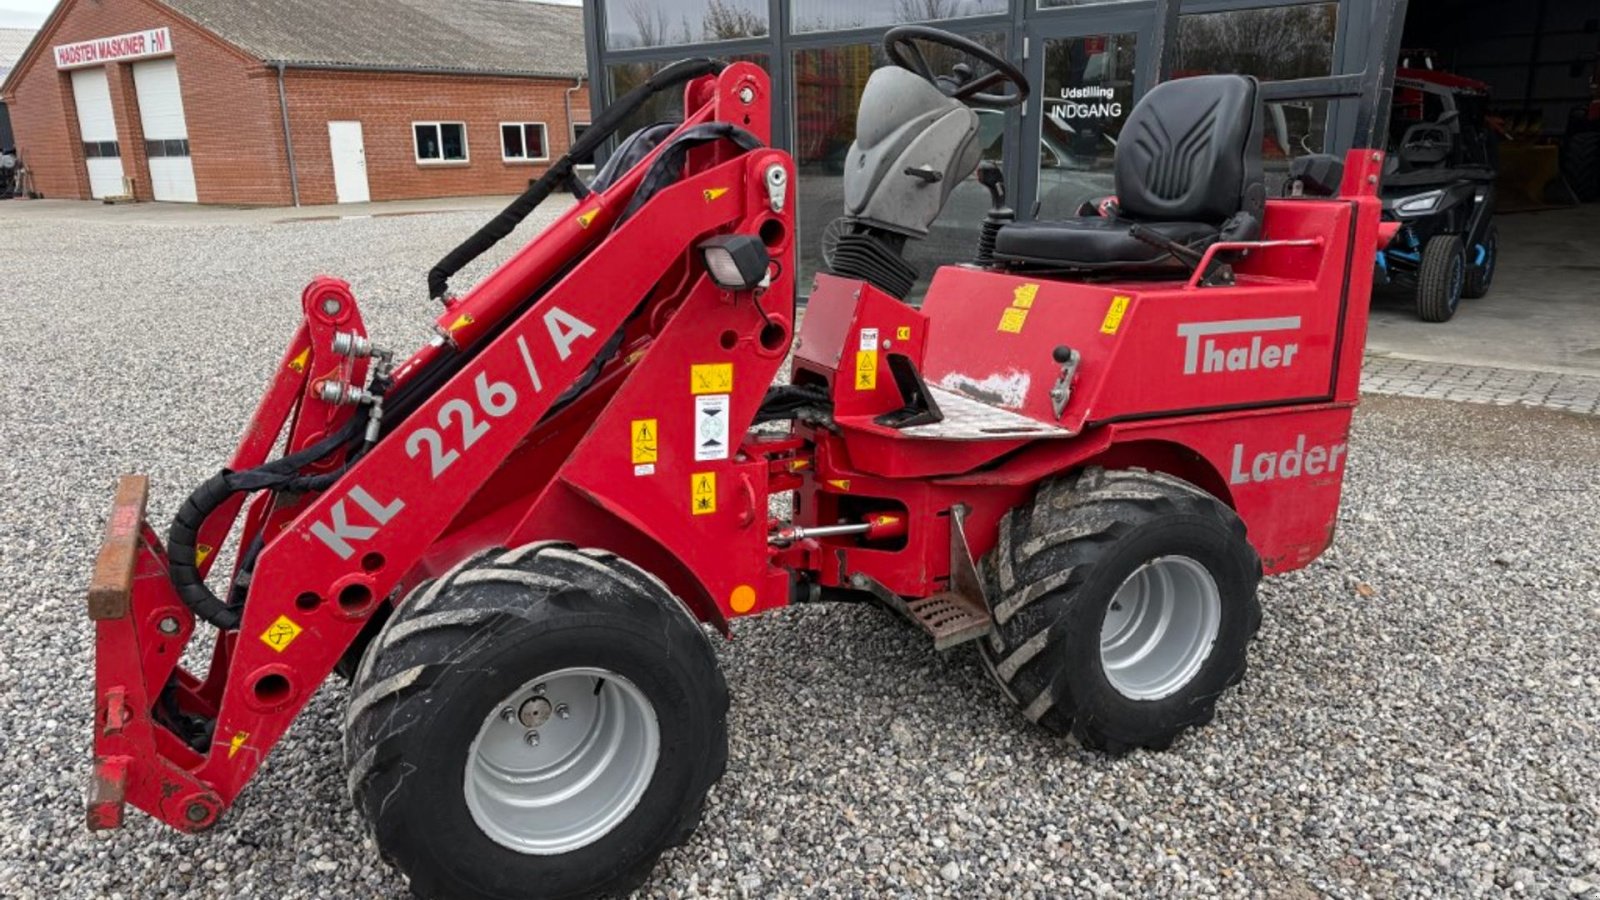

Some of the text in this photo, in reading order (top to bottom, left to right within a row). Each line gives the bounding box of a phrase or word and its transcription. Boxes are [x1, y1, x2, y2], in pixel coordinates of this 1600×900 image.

[58, 45, 97, 64] HADSTEN
[98, 35, 145, 59] MASKINER
[1052, 103, 1122, 119] INDGANG
[1061, 86, 1114, 99] Udstilling
[1177, 316, 1301, 375] Thaler
[1230, 434, 1346, 484] Lader
[310, 485, 406, 560] KL
